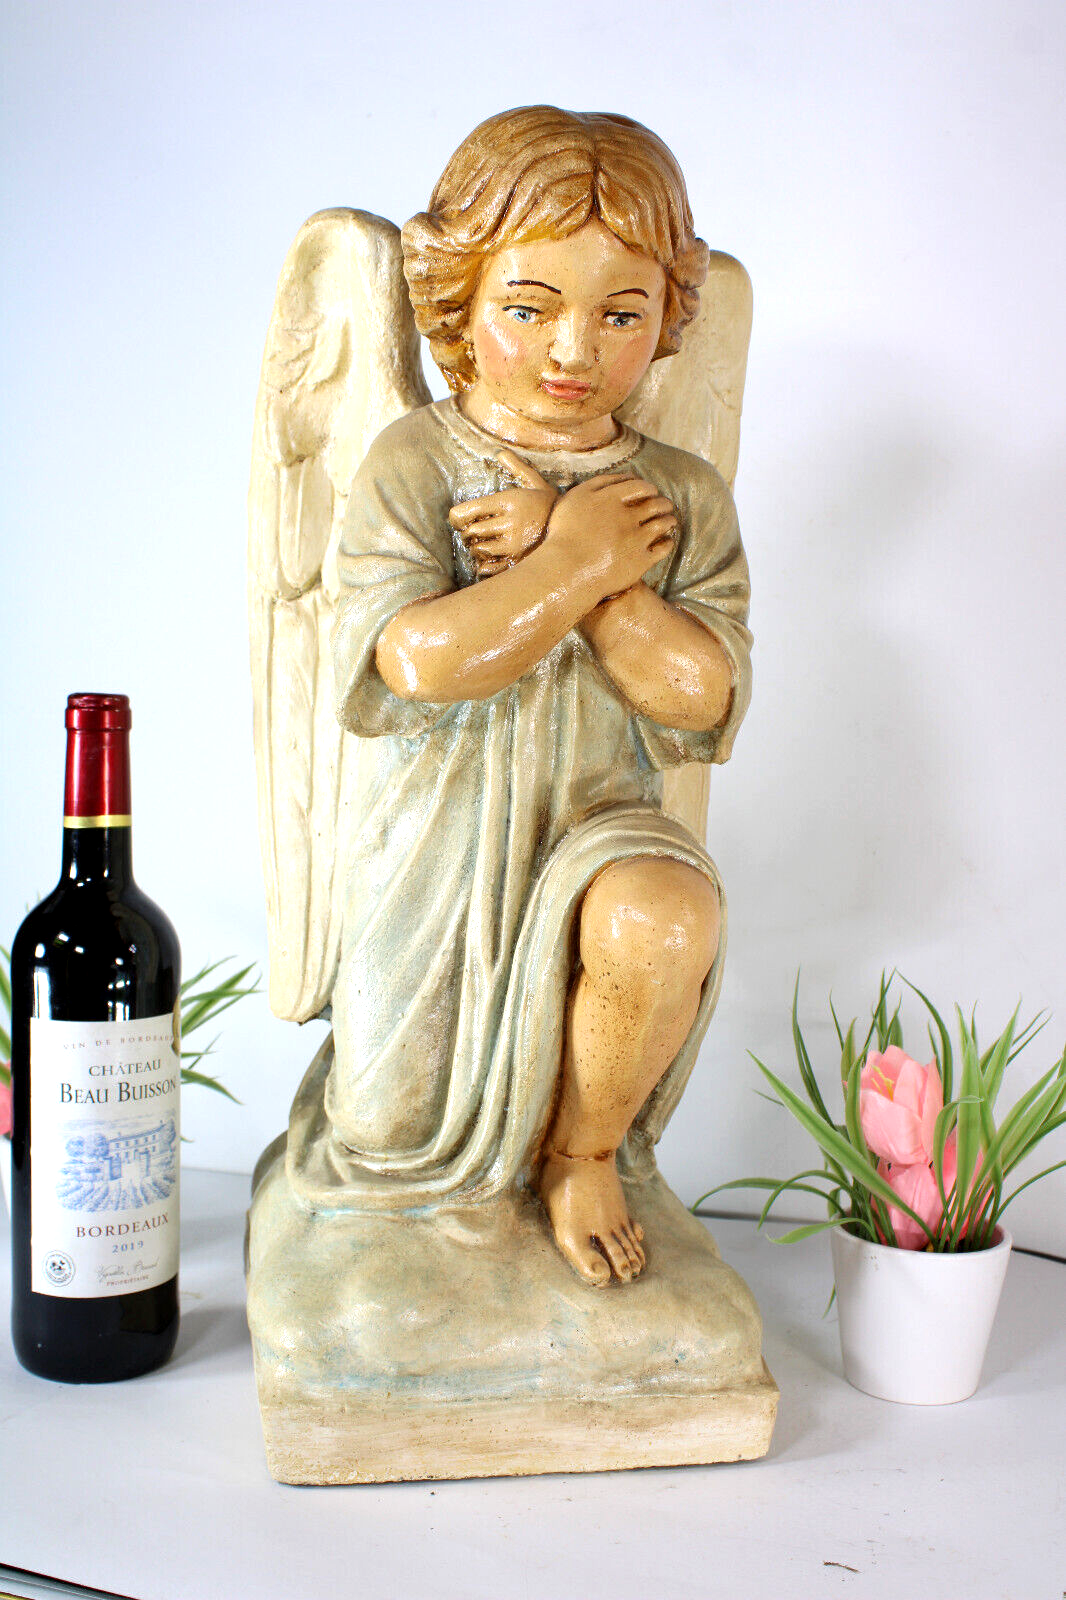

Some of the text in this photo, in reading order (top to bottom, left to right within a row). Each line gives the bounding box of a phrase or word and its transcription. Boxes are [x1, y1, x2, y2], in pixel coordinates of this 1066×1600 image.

[63, 1042, 86, 1050] VIN
[95, 1039, 112, 1047] DE
[88, 1058, 161, 1076] CHÂTEAU
[60, 1076, 177, 1104] BEAU BUISSON
[76, 1212, 169, 1238] BORDEAUX
[112, 1240, 144, 1253] 2019
